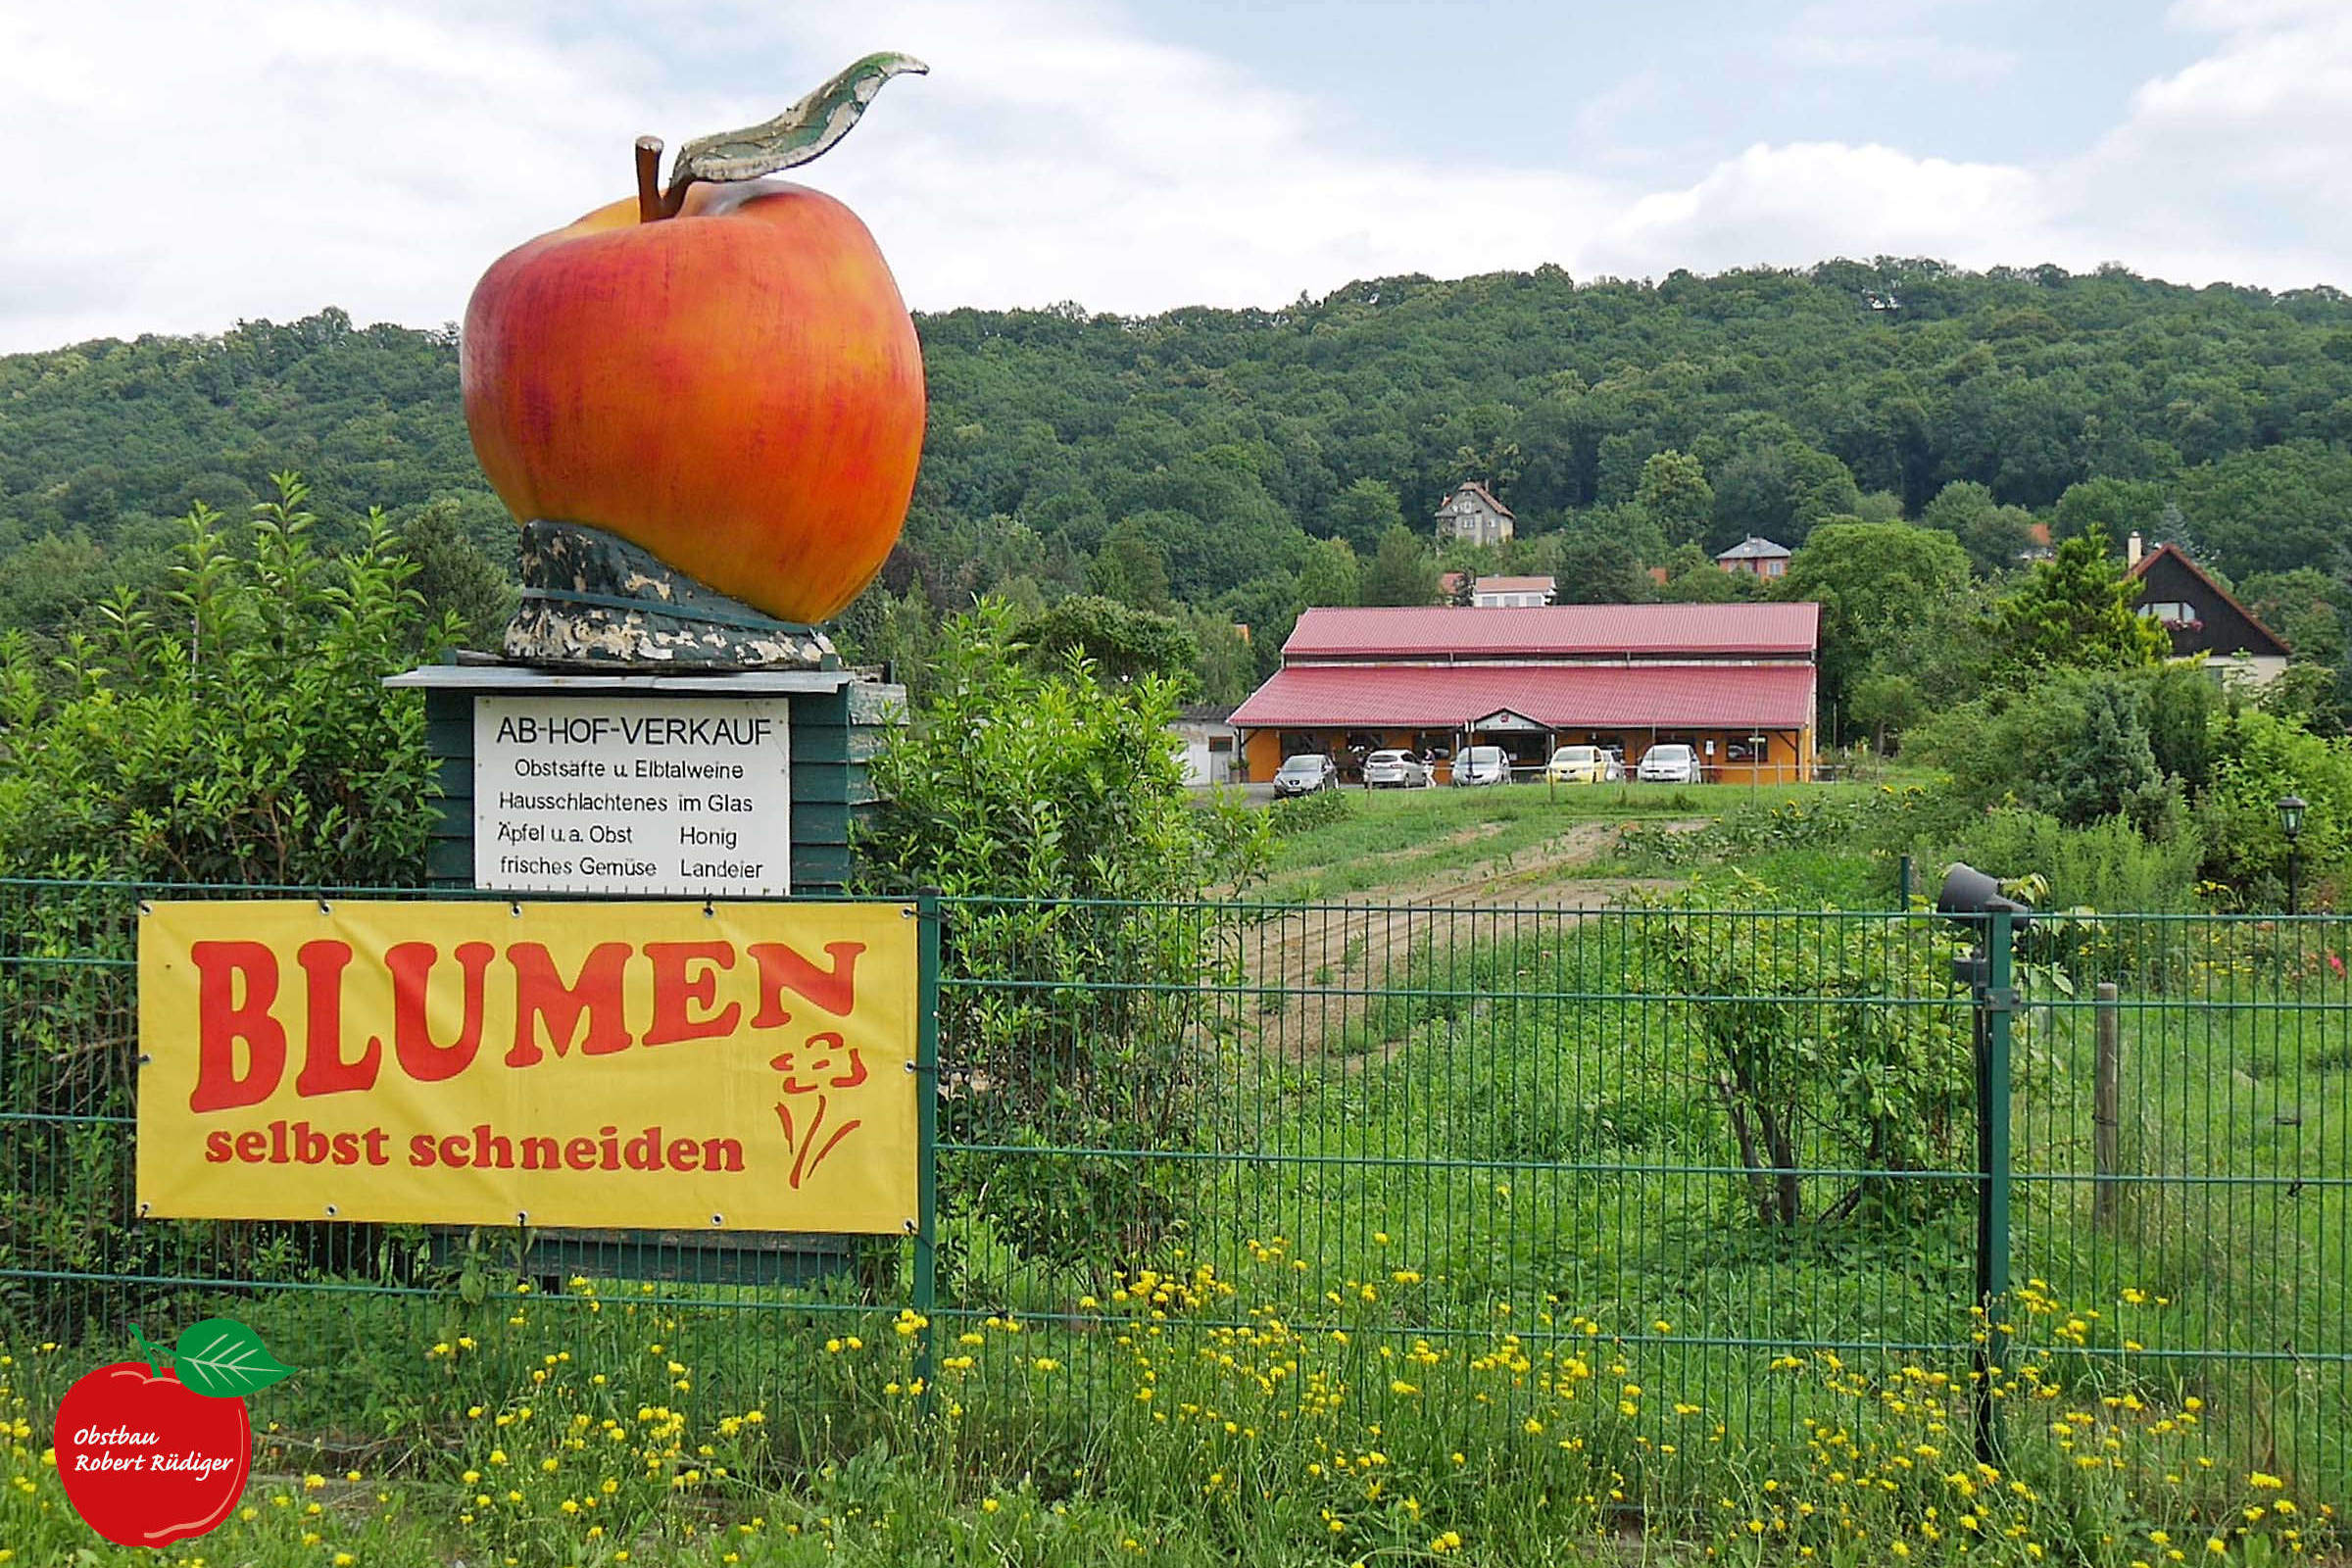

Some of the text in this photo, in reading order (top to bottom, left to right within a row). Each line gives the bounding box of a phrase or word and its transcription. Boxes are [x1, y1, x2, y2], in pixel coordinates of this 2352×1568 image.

[496, 716, 772, 746] AB-HOF-VERKAUF
[514, 759, 606, 778] Obstsäfte
[635, 760, 744, 779] Elbtalweine
[499, 792, 753, 813] Hausschlachtenes im Glas
[498, 821, 545, 847] Äpfel
[589, 825, 633, 844] Obst
[680, 826, 737, 850] Honig
[501, 856, 658, 877] frisches Gemüse
[680, 858, 764, 879] Landeier
[190, 940, 867, 1112] BLUMEN
[205, 1120, 746, 1172] selbst schneiden
